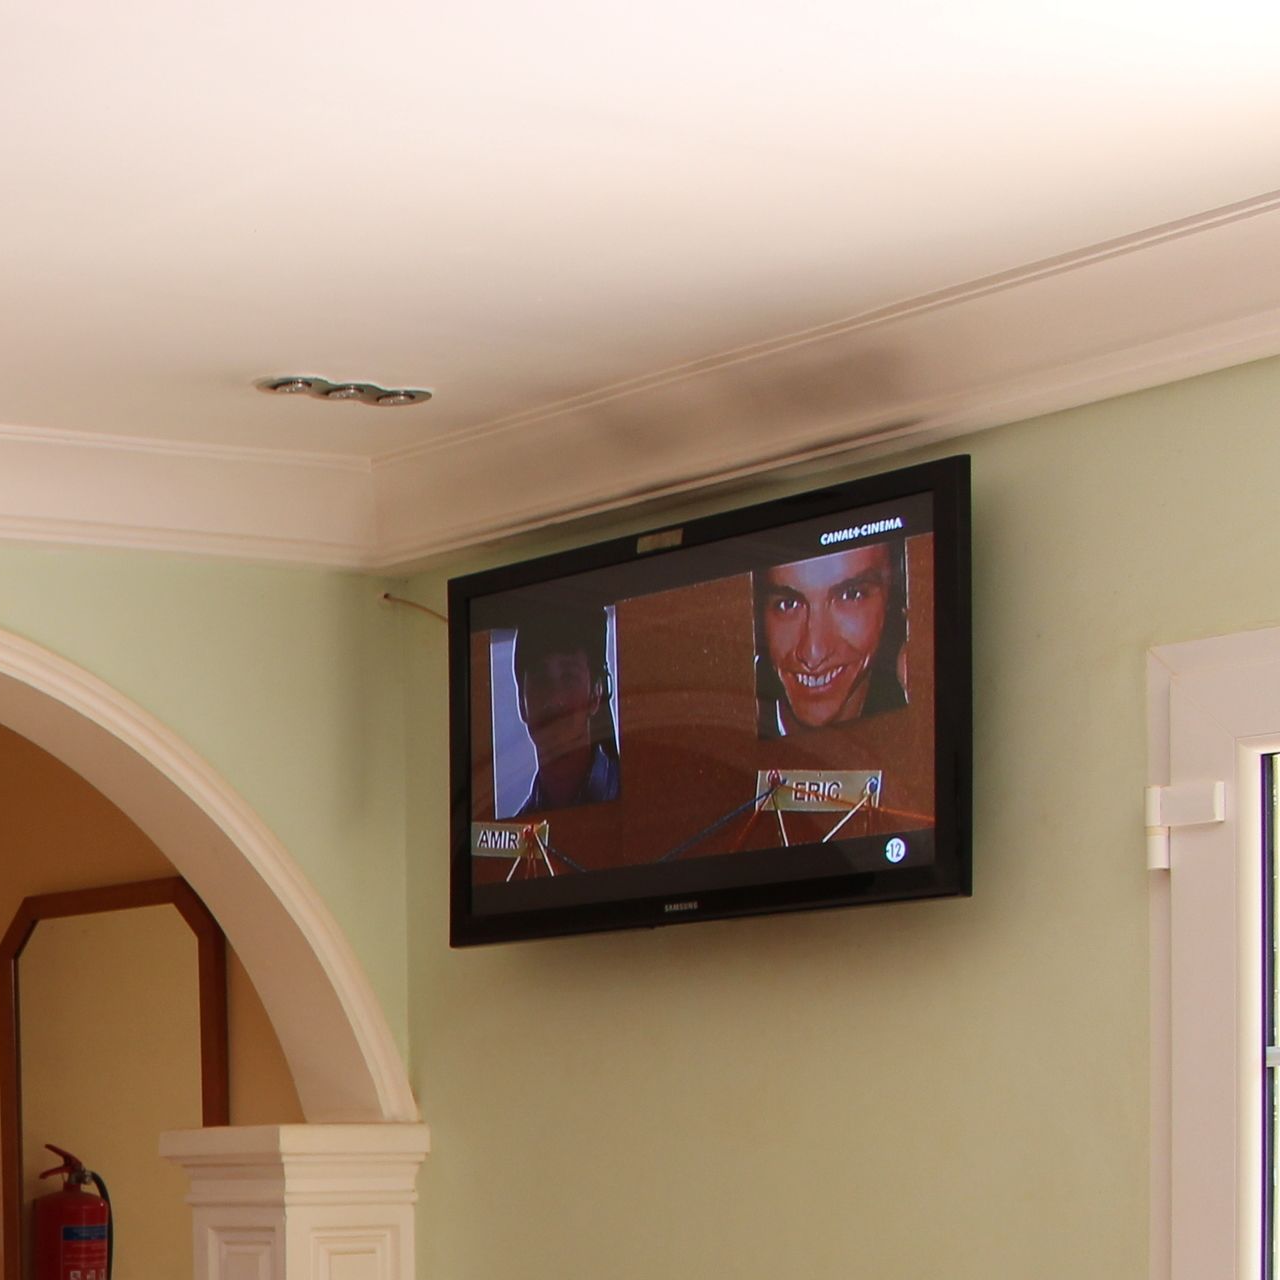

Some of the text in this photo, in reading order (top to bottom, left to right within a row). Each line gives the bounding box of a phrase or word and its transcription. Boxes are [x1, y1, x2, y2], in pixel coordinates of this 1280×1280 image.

[820, 516, 903, 545] CANAL+CINEMA
[792, 781, 842, 802] ERIC
[477, 829, 520, 849] AMIR
